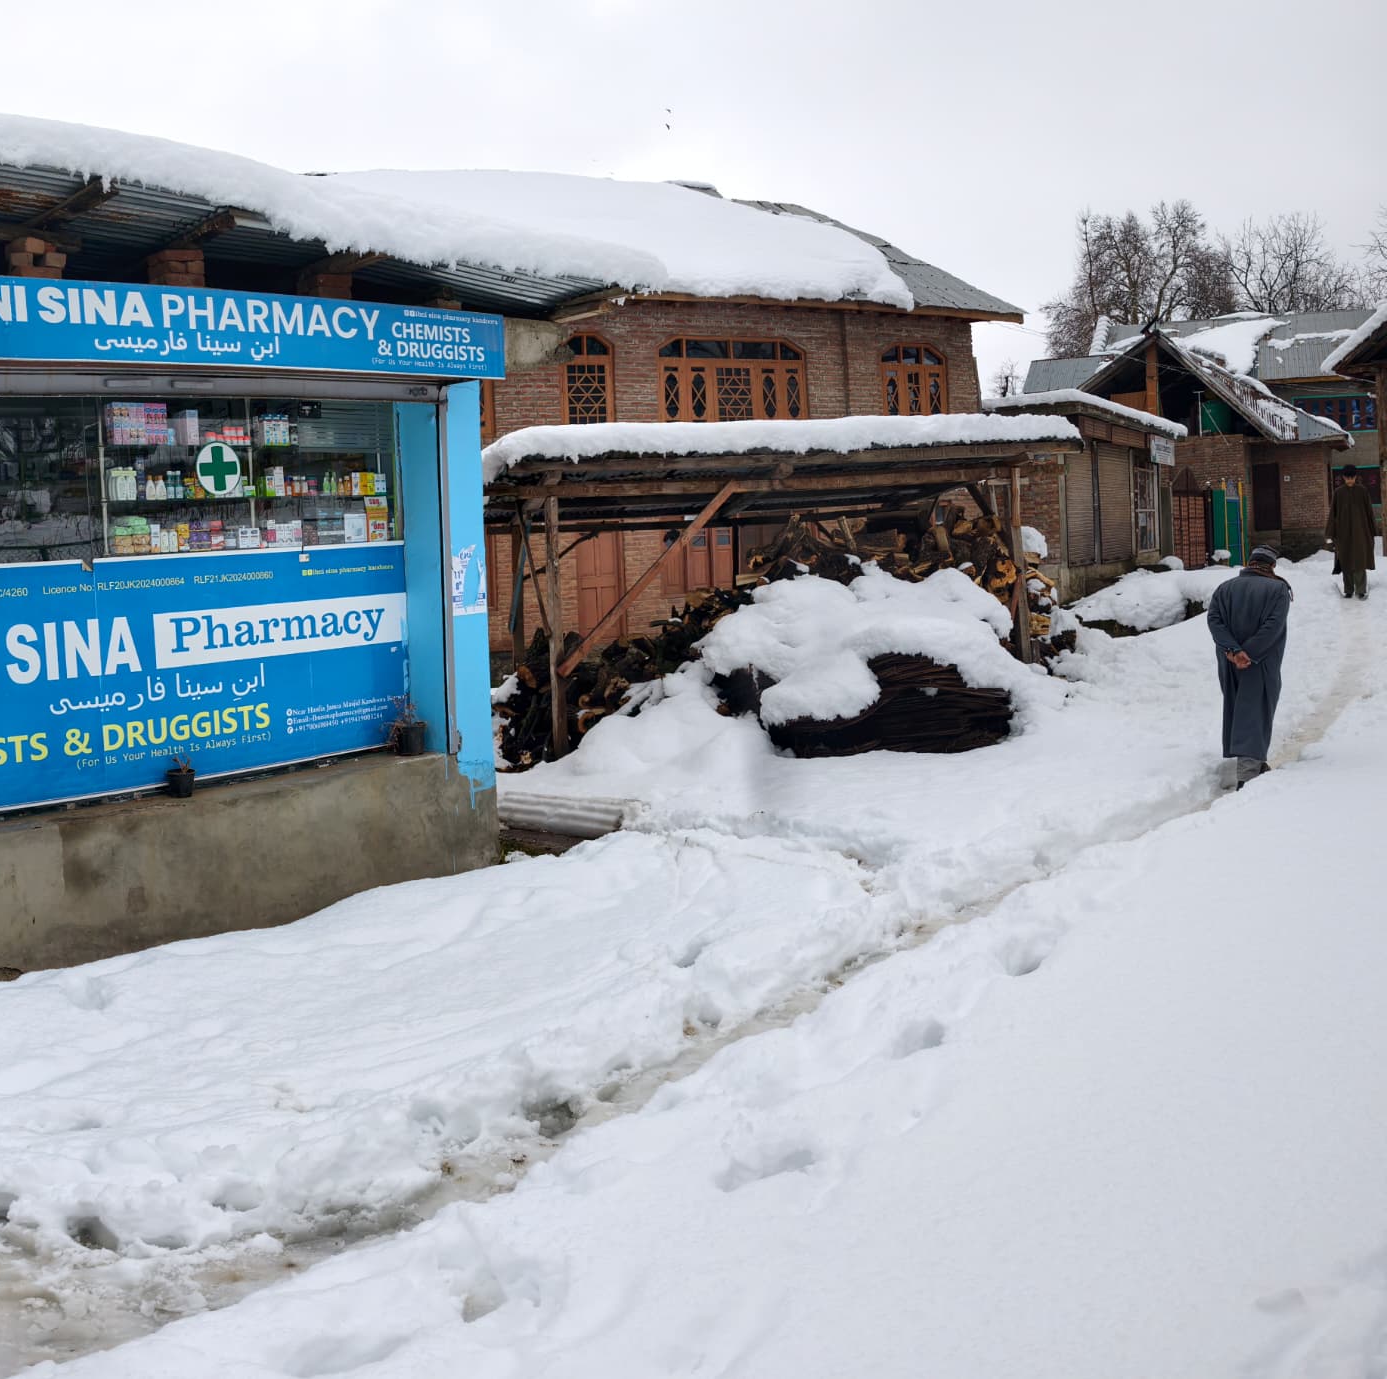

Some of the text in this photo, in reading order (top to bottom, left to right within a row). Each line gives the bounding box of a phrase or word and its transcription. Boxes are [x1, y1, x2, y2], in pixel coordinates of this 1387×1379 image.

[36, 286, 154, 328] SINA
[160, 293, 380, 341] PHARMACY
[196, 331, 241, 357] سینا
[391, 321, 471, 344] CHEMISTS
[377, 339, 485, 362] & DRUGGISTS
[398, 358, 412, 367] Your
[414, 359, 435, 368] Health
[42, 583, 77, 595] Licence
[5, 615, 143, 685] SINA
[169, 607, 385, 654] Pharmacy
[175, 672, 224, 701] سینا
[63, 727, 93, 757] &
[101, 702, 271, 752] DRUGGISTS
[76, 731, 272, 770] (For Us Your Health Is Always First)
